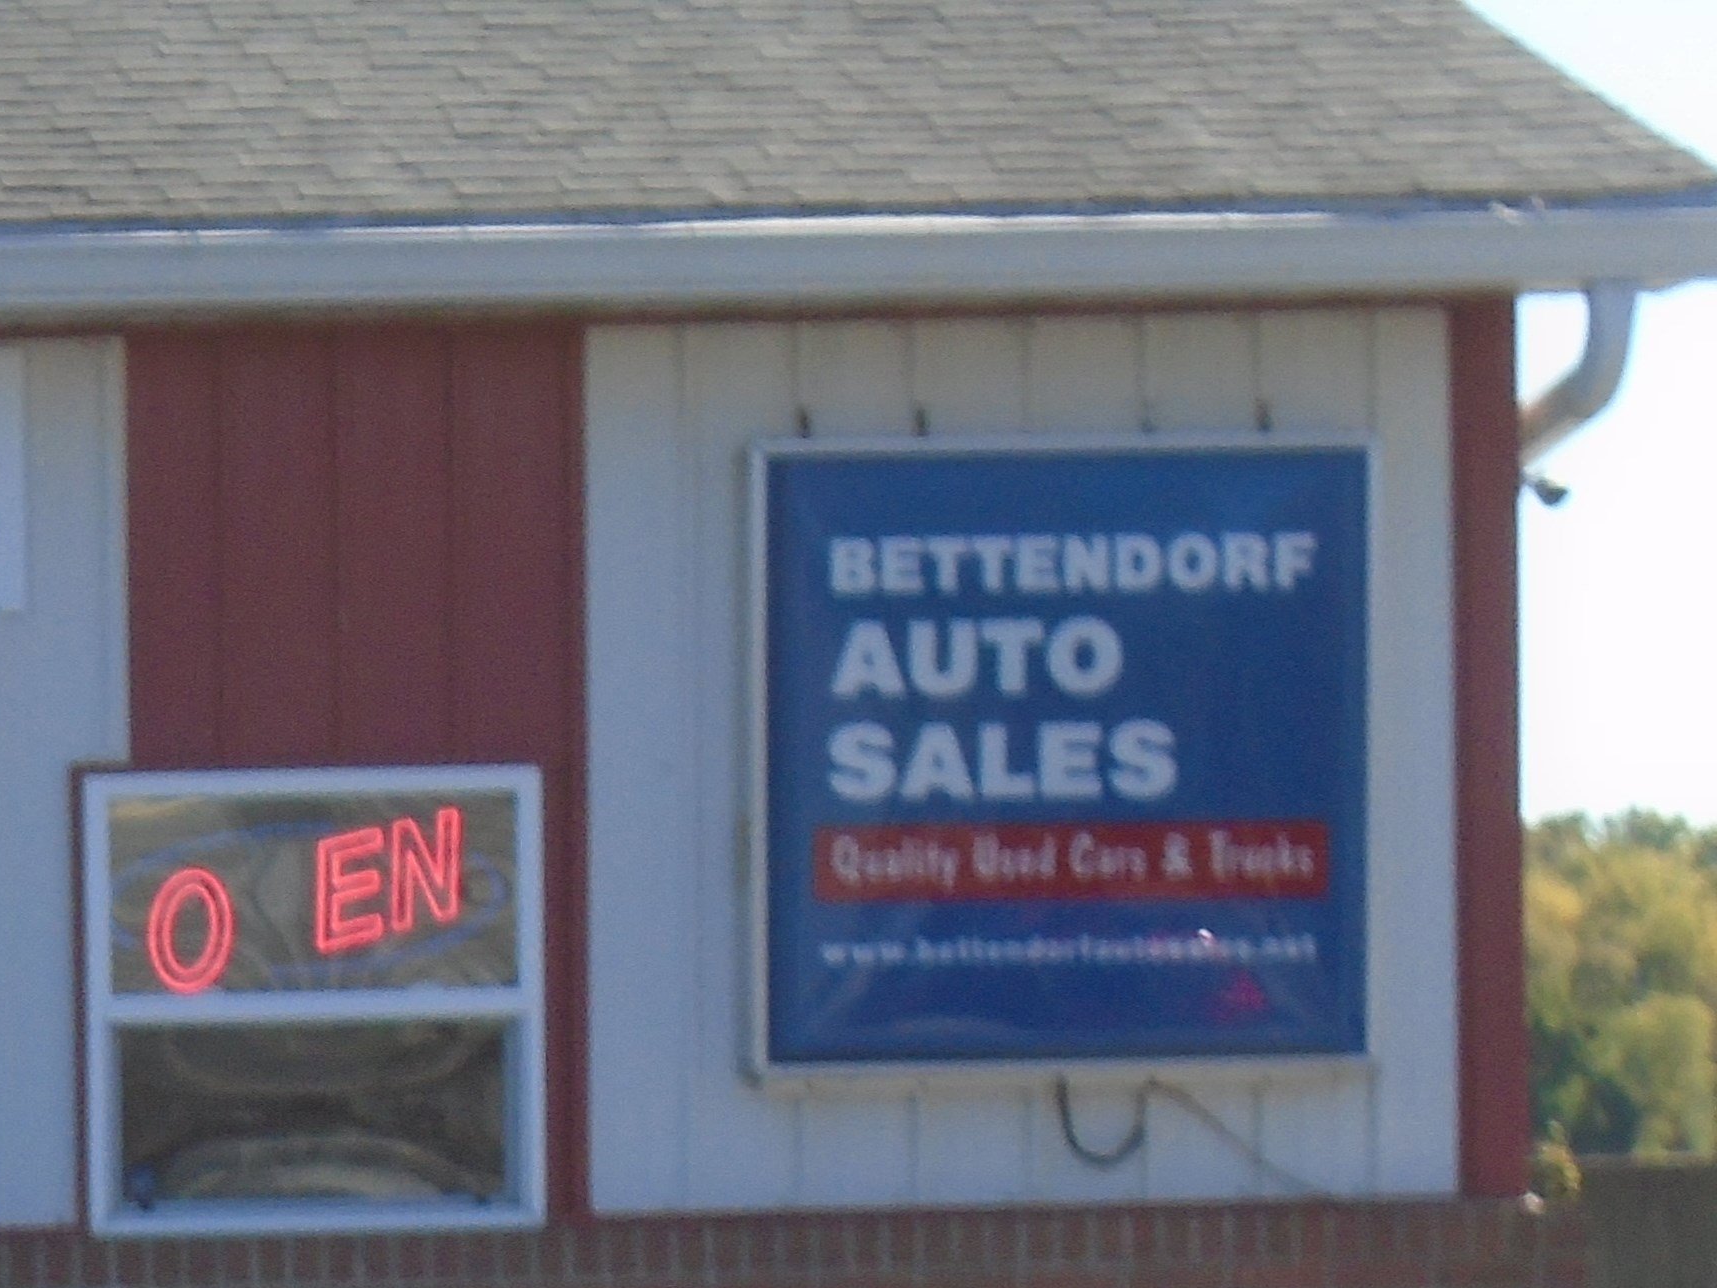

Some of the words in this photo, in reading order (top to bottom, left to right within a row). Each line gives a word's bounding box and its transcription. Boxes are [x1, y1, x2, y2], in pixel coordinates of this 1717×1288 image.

[828, 531, 1317, 596] BETTENDORF
[830, 615, 1124, 698] AUTO
[826, 718, 1179, 802] SALES
[830, 833, 957, 888] Quality
[972, 832, 1057, 879] Used
[1068, 832, 1146, 880] Cars
[1163, 831, 1193, 879] &
[1210, 829, 1314, 880] Trucks
[147, 806, 464, 995] OEN
